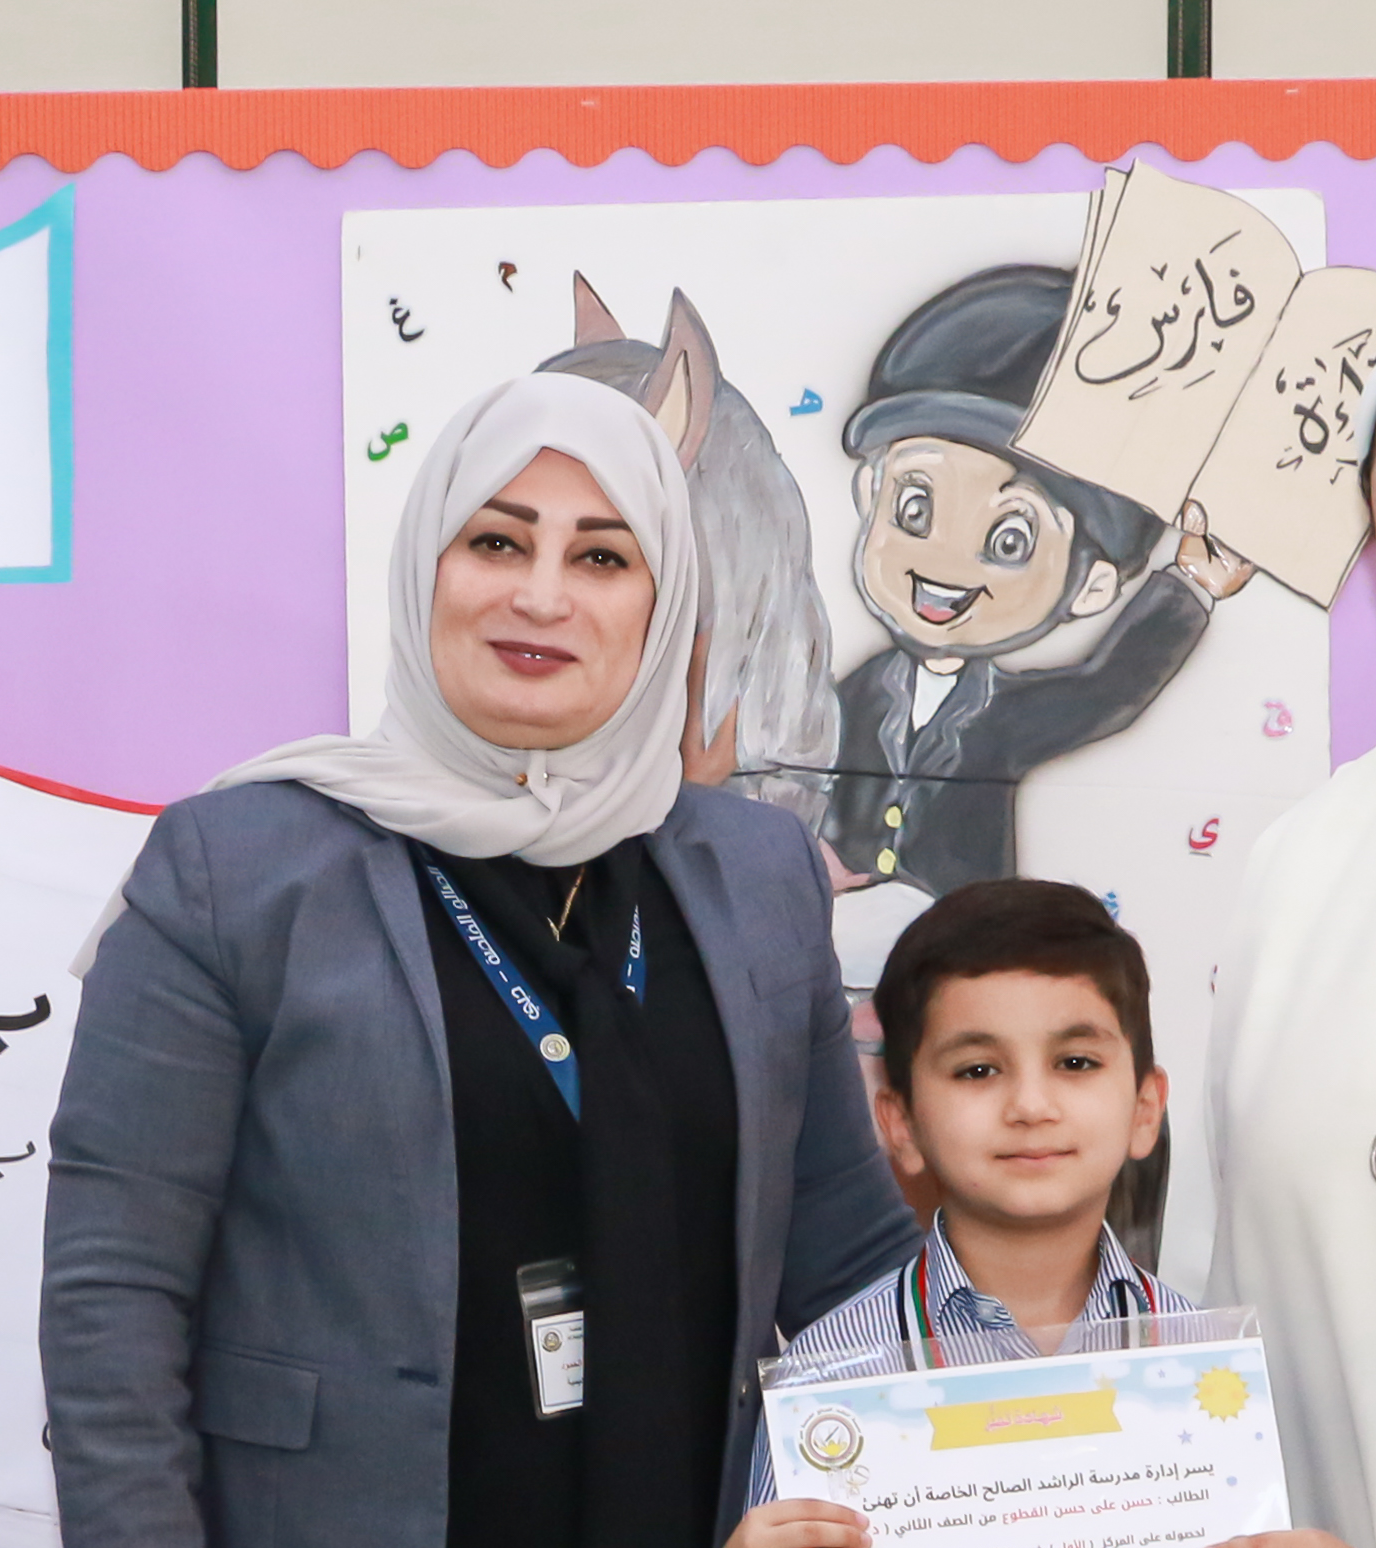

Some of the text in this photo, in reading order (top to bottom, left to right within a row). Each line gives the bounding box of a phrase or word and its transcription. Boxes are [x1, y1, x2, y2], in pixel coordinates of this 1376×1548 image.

[389, 298, 425, 342] غ
[367, 422, 409, 462] ص
[511, 986, 541, 1021] دبي
[1089, 1470, 1141, 1486] مدرسة
[1145, 1463, 1180, 1481] إدارة
[1184, 1463, 1214, 1478] يسر
[1037, 1472, 1084, 1490] الراشد
[904, 1486, 921, 1507] أن
[925, 1483, 977, 1501] الخاصة
[982, 1478, 1032, 1502] الصالح
[1166, 1489, 1209, 1506] الطالب
[1053, 1505, 1086, 1518] حسن
[1121, 1496, 1153, 1511] حسن
[894, 1518, 932, 1538] الثاني
[937, 1514, 973, 1528] الصف
[978, 1514, 997, 1526] من
[1139, 1532, 1161, 1546] على
[1165, 1527, 1205, 1542] لحصوله
